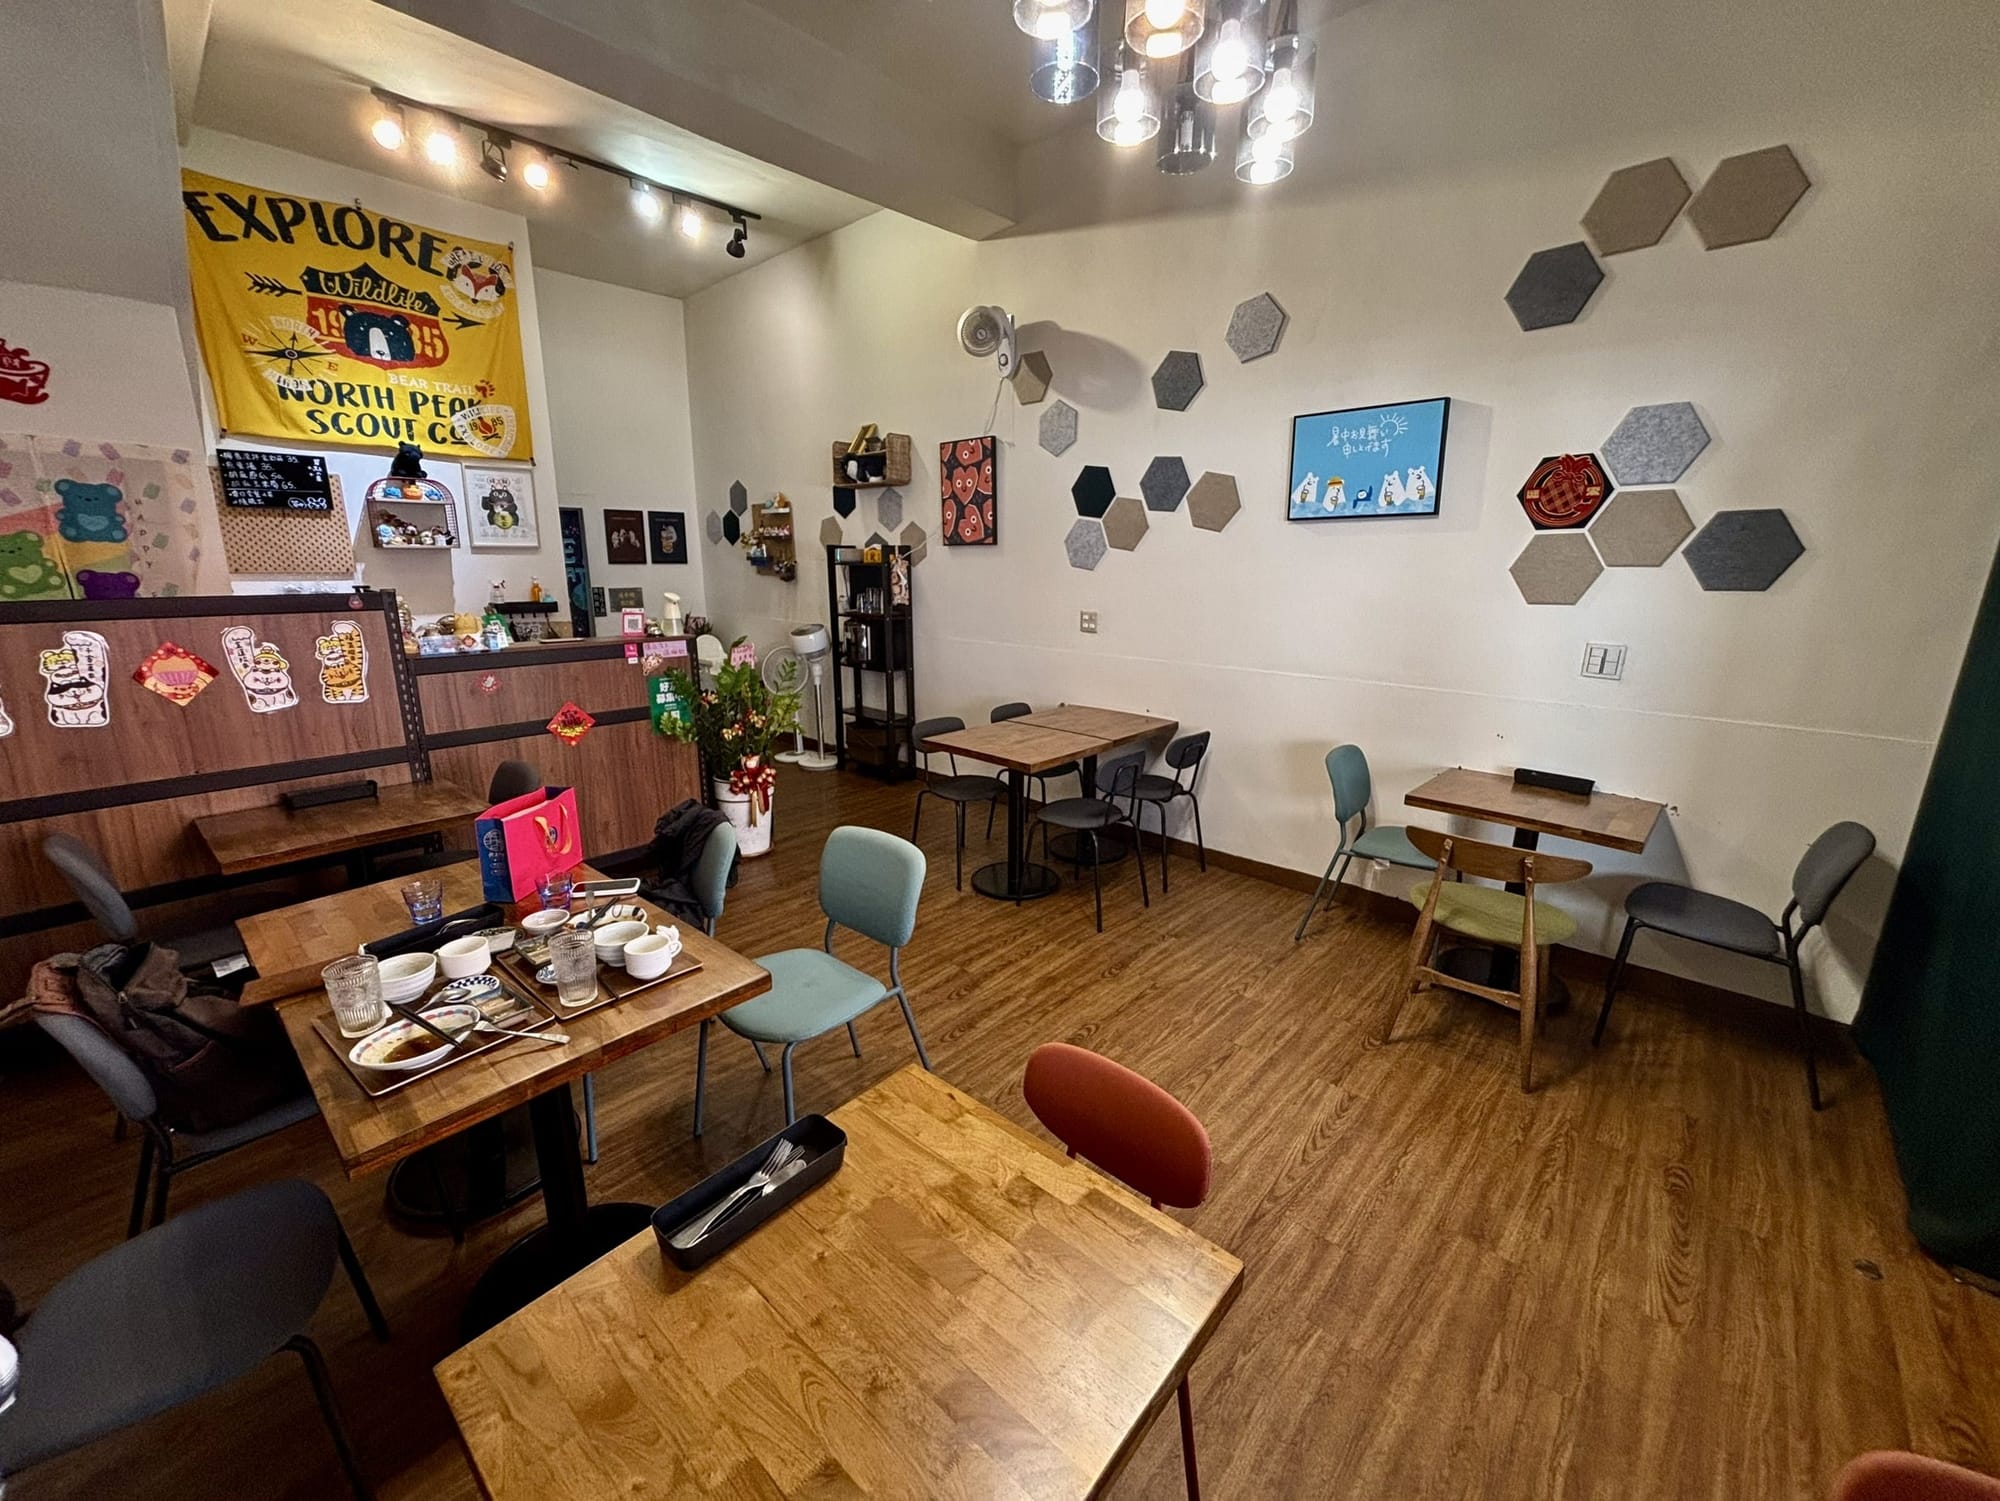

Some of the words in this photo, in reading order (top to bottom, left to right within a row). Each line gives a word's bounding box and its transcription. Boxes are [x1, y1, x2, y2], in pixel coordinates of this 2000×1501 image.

[318, 271, 430, 312] Wildlife
[388, 373, 429, 390] BEAR
[432, 381, 476, 396] TRAIL
[306, 408, 417, 441] SCOUT
